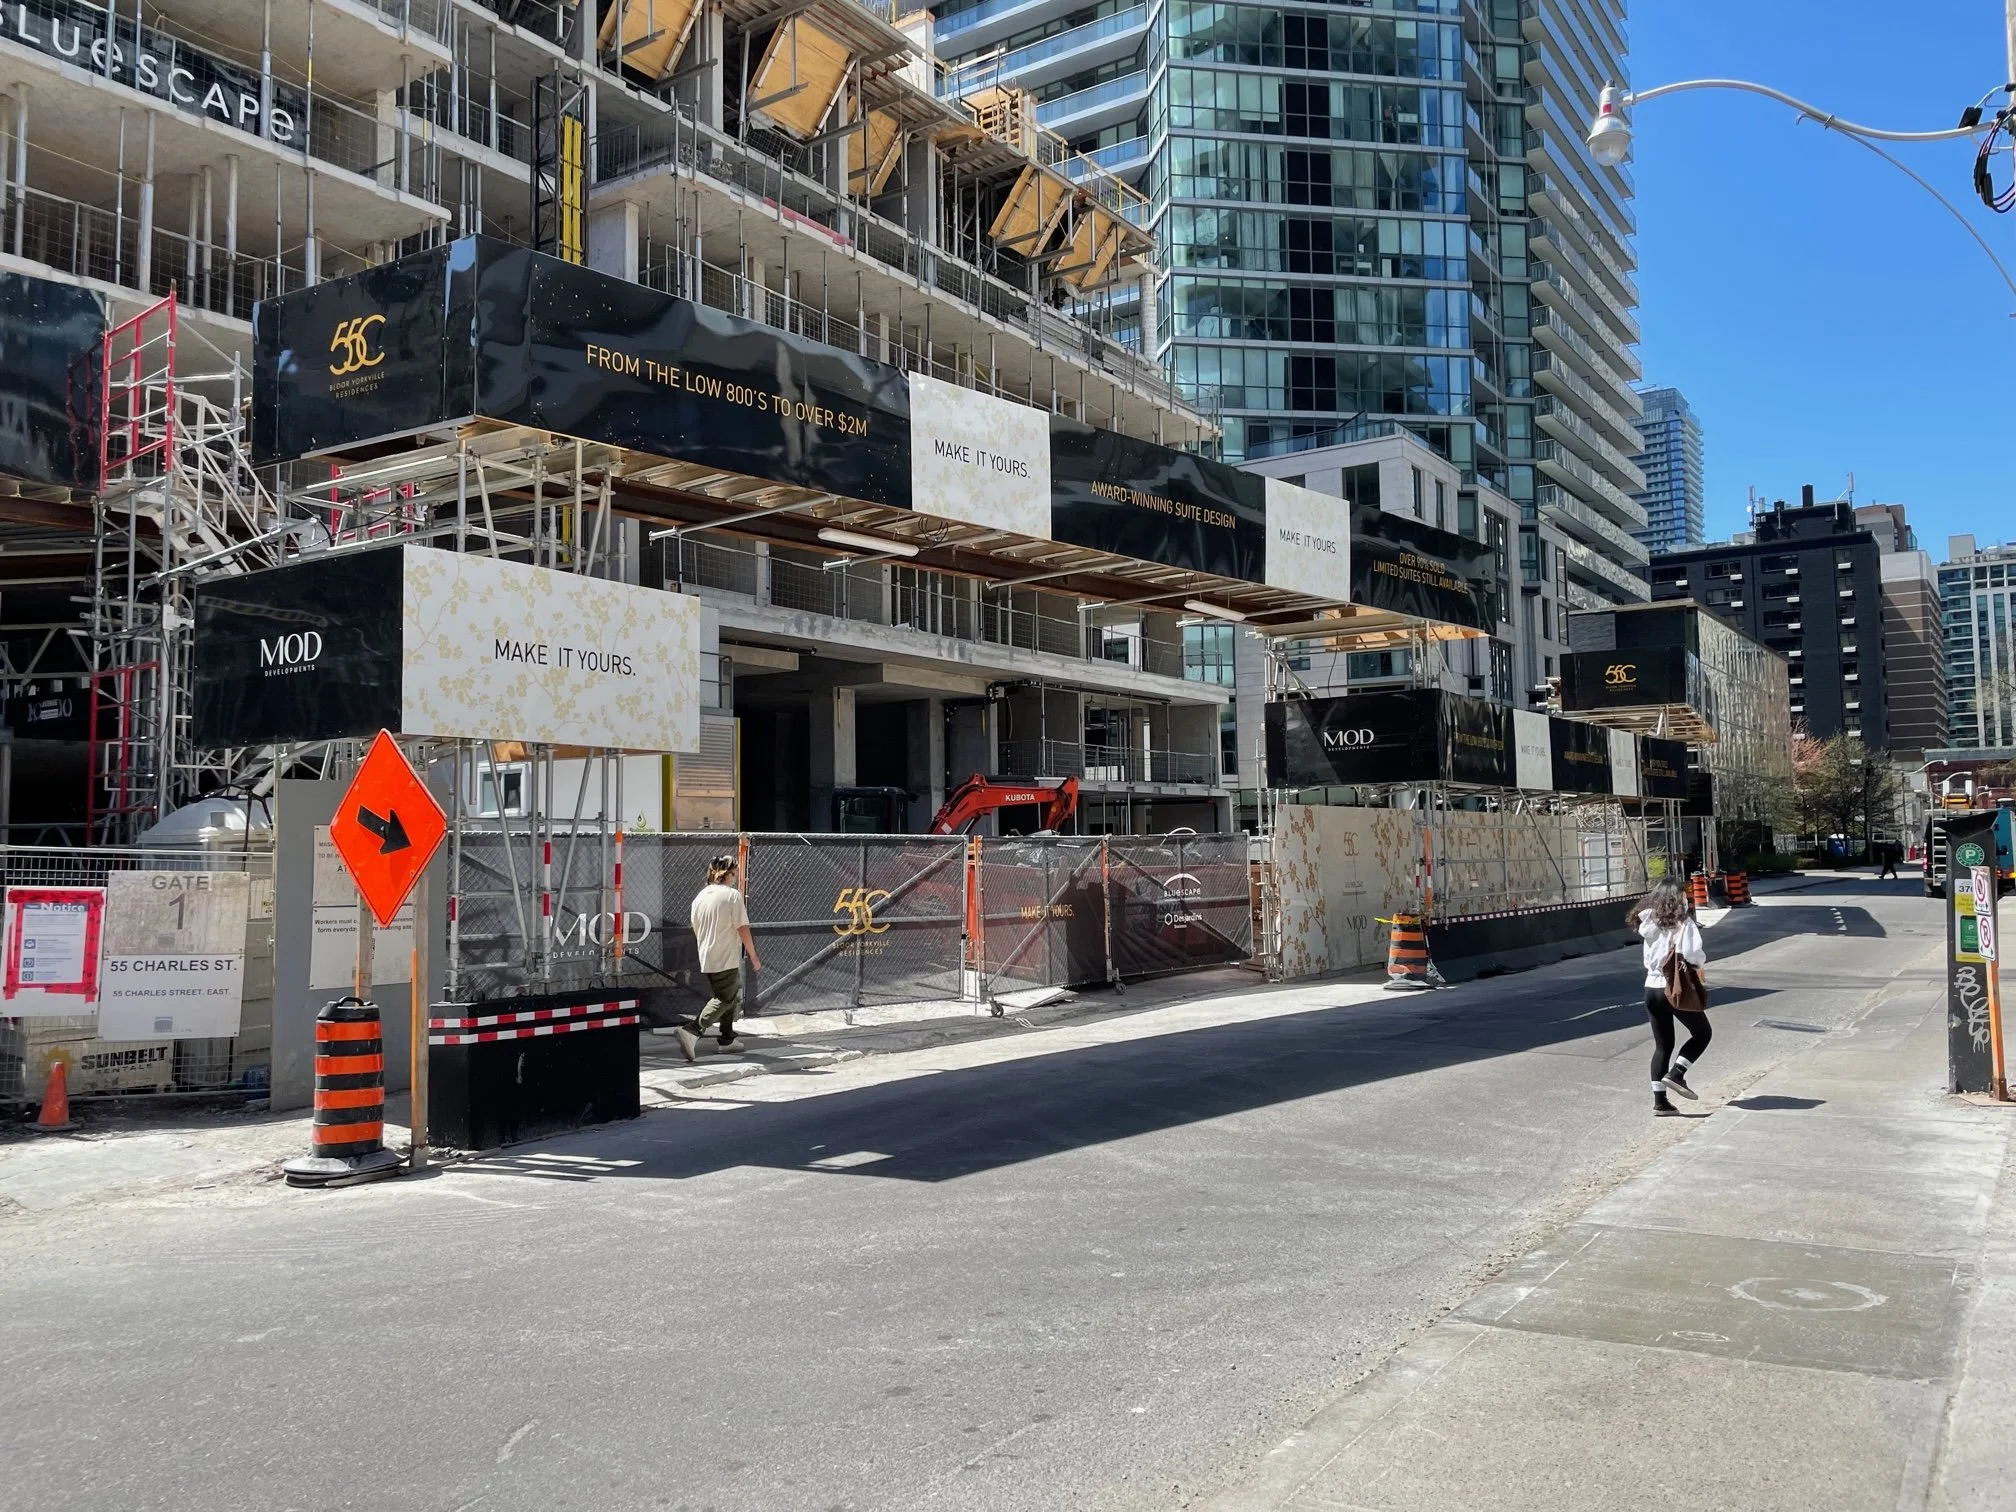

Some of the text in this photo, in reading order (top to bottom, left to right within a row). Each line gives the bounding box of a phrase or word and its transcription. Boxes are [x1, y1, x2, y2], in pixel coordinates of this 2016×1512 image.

[329, 314, 387, 376] 55C
[329, 371, 385, 392] BLOOR YORKVILLE
[336, 383, 378, 399] RESIDENCES
[586, 343, 868, 437] FROM THE LOW 800'S TO OVER $2M
[934, 439, 1031, 479] MAKE IT YOURS.
[1091, 480, 1236, 530] AWARD-WINNING SUITE DESIGN
[1280, 528, 1300, 546] MAKE
[1304, 535, 1311, 548] IT
[1399, 552, 1416, 567] OVER
[1429, 560, 1446, 575] SOLD
[1374, 559, 1469, 594] LIMITED SUITES STILL AVAILABLE
[260, 631, 323, 668] MOD
[495, 638, 636, 676] MAKE IT YOURS.
[265, 664, 315, 677] DEVELOPMENTS
[1605, 664, 1637, 684] 55C
[1323, 729, 1375, 747] MOD
[1005, 793, 1035, 802] KUBOTA
[152, 875, 209, 891] GATE
[40, 902, 86, 913] Notice
[168, 893, 185, 930] 1
[833, 888, 892, 936] 55C
[1021, 905, 1041, 919] MAKE
[1051, 904, 1075, 918] YOURS.
[1174, 912, 1203, 924] Desjardins
[333, 926, 357, 934] everyda
[550, 911, 652, 947] MOD
[110, 959, 237, 972] 55 CHARLES ST.
[125, 989, 167, 997] CHARLES
[81, 1046, 168, 1070] SUNBELT
